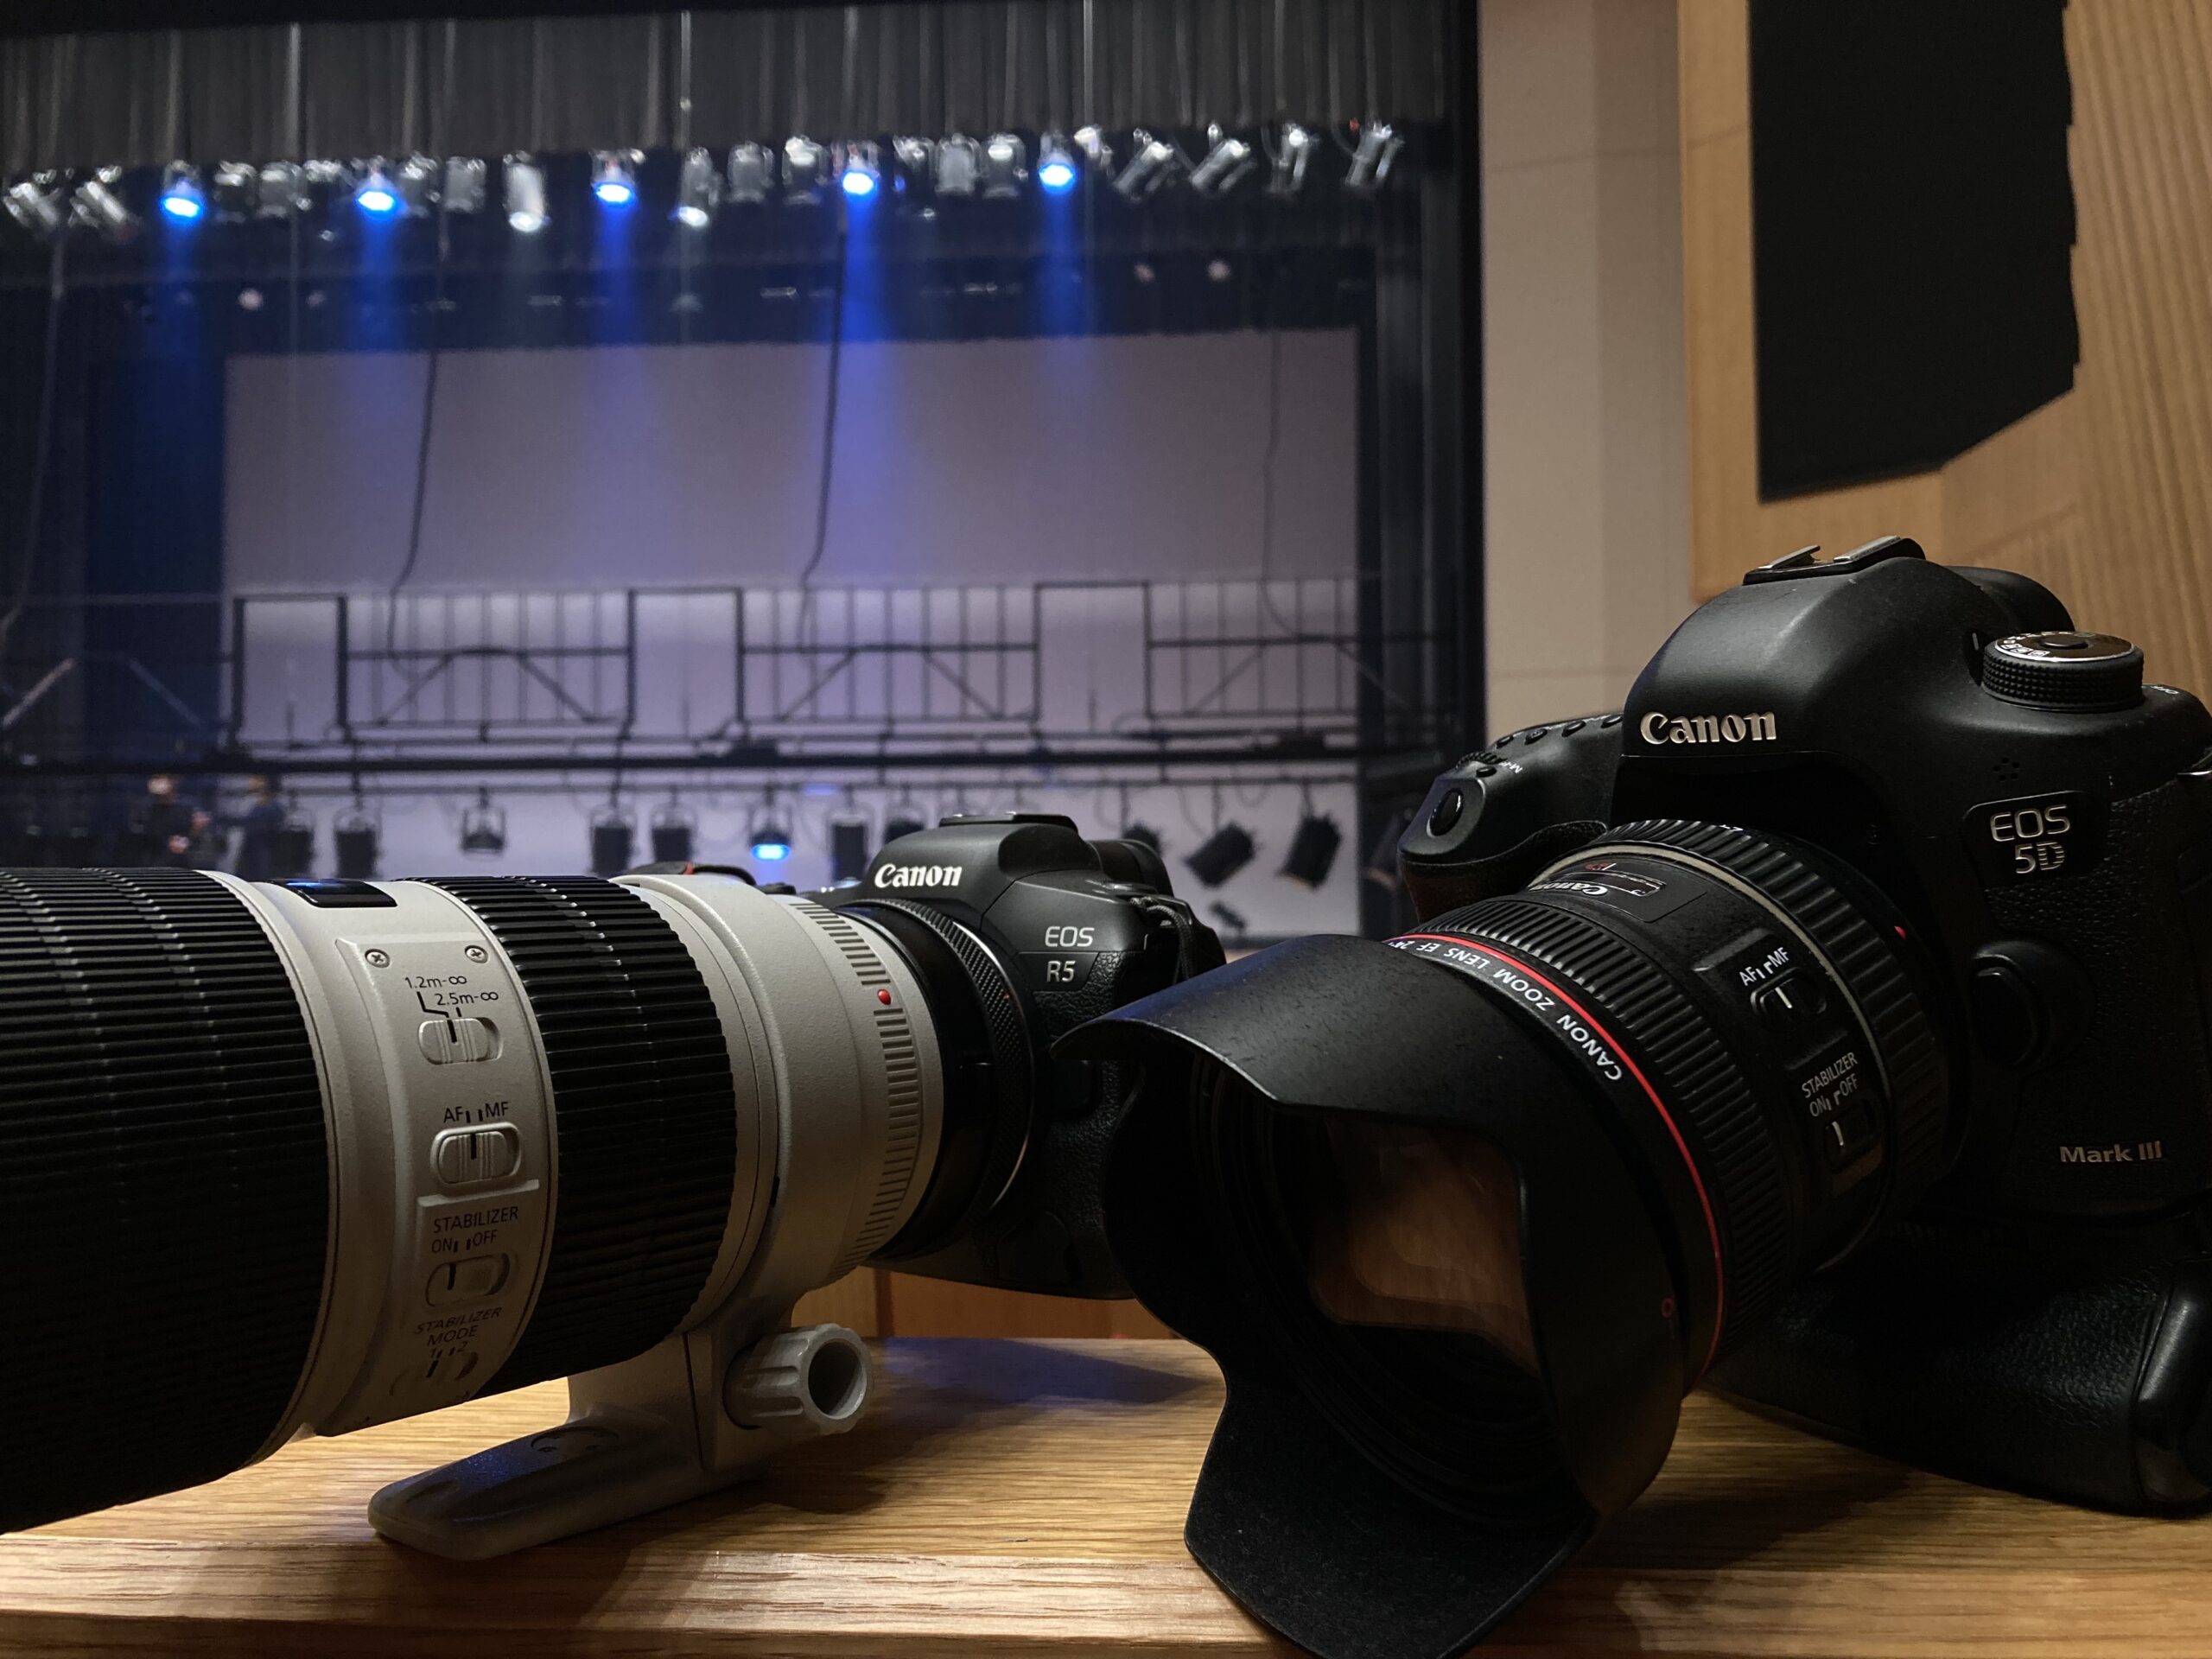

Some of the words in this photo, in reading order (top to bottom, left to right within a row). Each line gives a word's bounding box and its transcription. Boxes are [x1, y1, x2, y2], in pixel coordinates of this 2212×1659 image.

[1640, 711, 1777, 745] Canon
[1990, 804, 2070, 842] EOS
[2015, 841, 2065, 874] 5D
[874, 863, 963, 888] Canon
[1045, 925, 1095, 948] EOS
[1416, 941, 1442, 953] EF
[1046, 960, 1077, 983] R5
[1443, 947, 1491, 969] LENS
[1739, 966, 1758, 986] AF
[1767, 947, 1789, 967] MF
[1493, 968, 1554, 1011] ZOOM
[1555, 1014, 1623, 1081] CANON
[1802, 1052, 1858, 1098] STABILIZER
[1809, 1095, 1827, 1117] ON
[1840, 1073, 1858, 1096] OFF
[443, 1106, 463, 1123] AF
[486, 1102, 509, 1118] MF
[2059, 1143, 2133, 1163] Mark
[2138, 1141, 2163, 1160] III
[433, 1206, 518, 1234] STABILIZER
[432, 1238, 453, 1253] ON
[473, 1229, 498, 1246] OFF
[414, 1306, 502, 1335] STABILIZER
[427, 1325, 479, 1347] MODE
